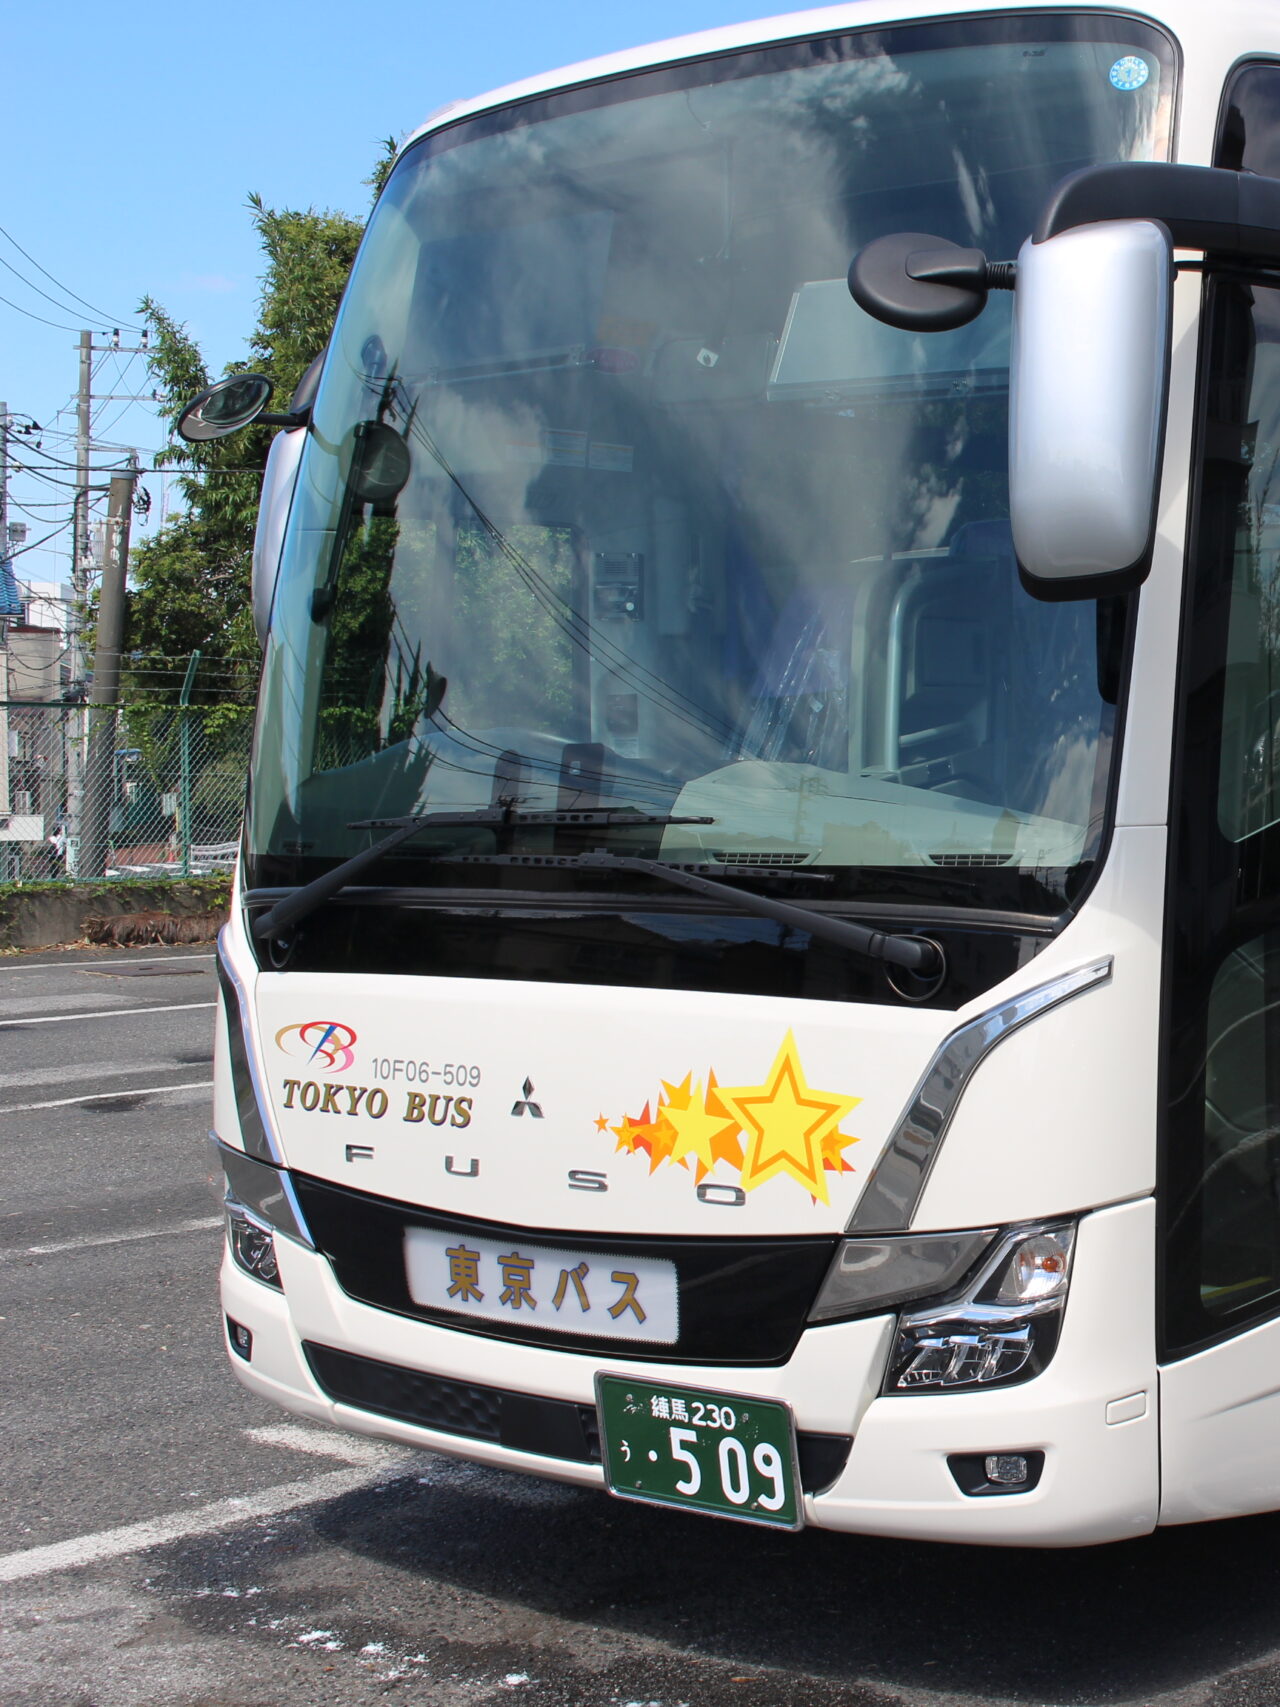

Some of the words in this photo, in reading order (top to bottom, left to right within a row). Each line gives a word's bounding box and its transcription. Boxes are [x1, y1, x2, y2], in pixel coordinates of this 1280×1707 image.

[371, 1057, 481, 1088] 10F06-509
[283, 1078, 389, 1119] TOKYO
[403, 1091, 473, 1129] BUS
[345, 1143, 747, 1207] FUSO
[445, 1244, 647, 1326] 東京バス
